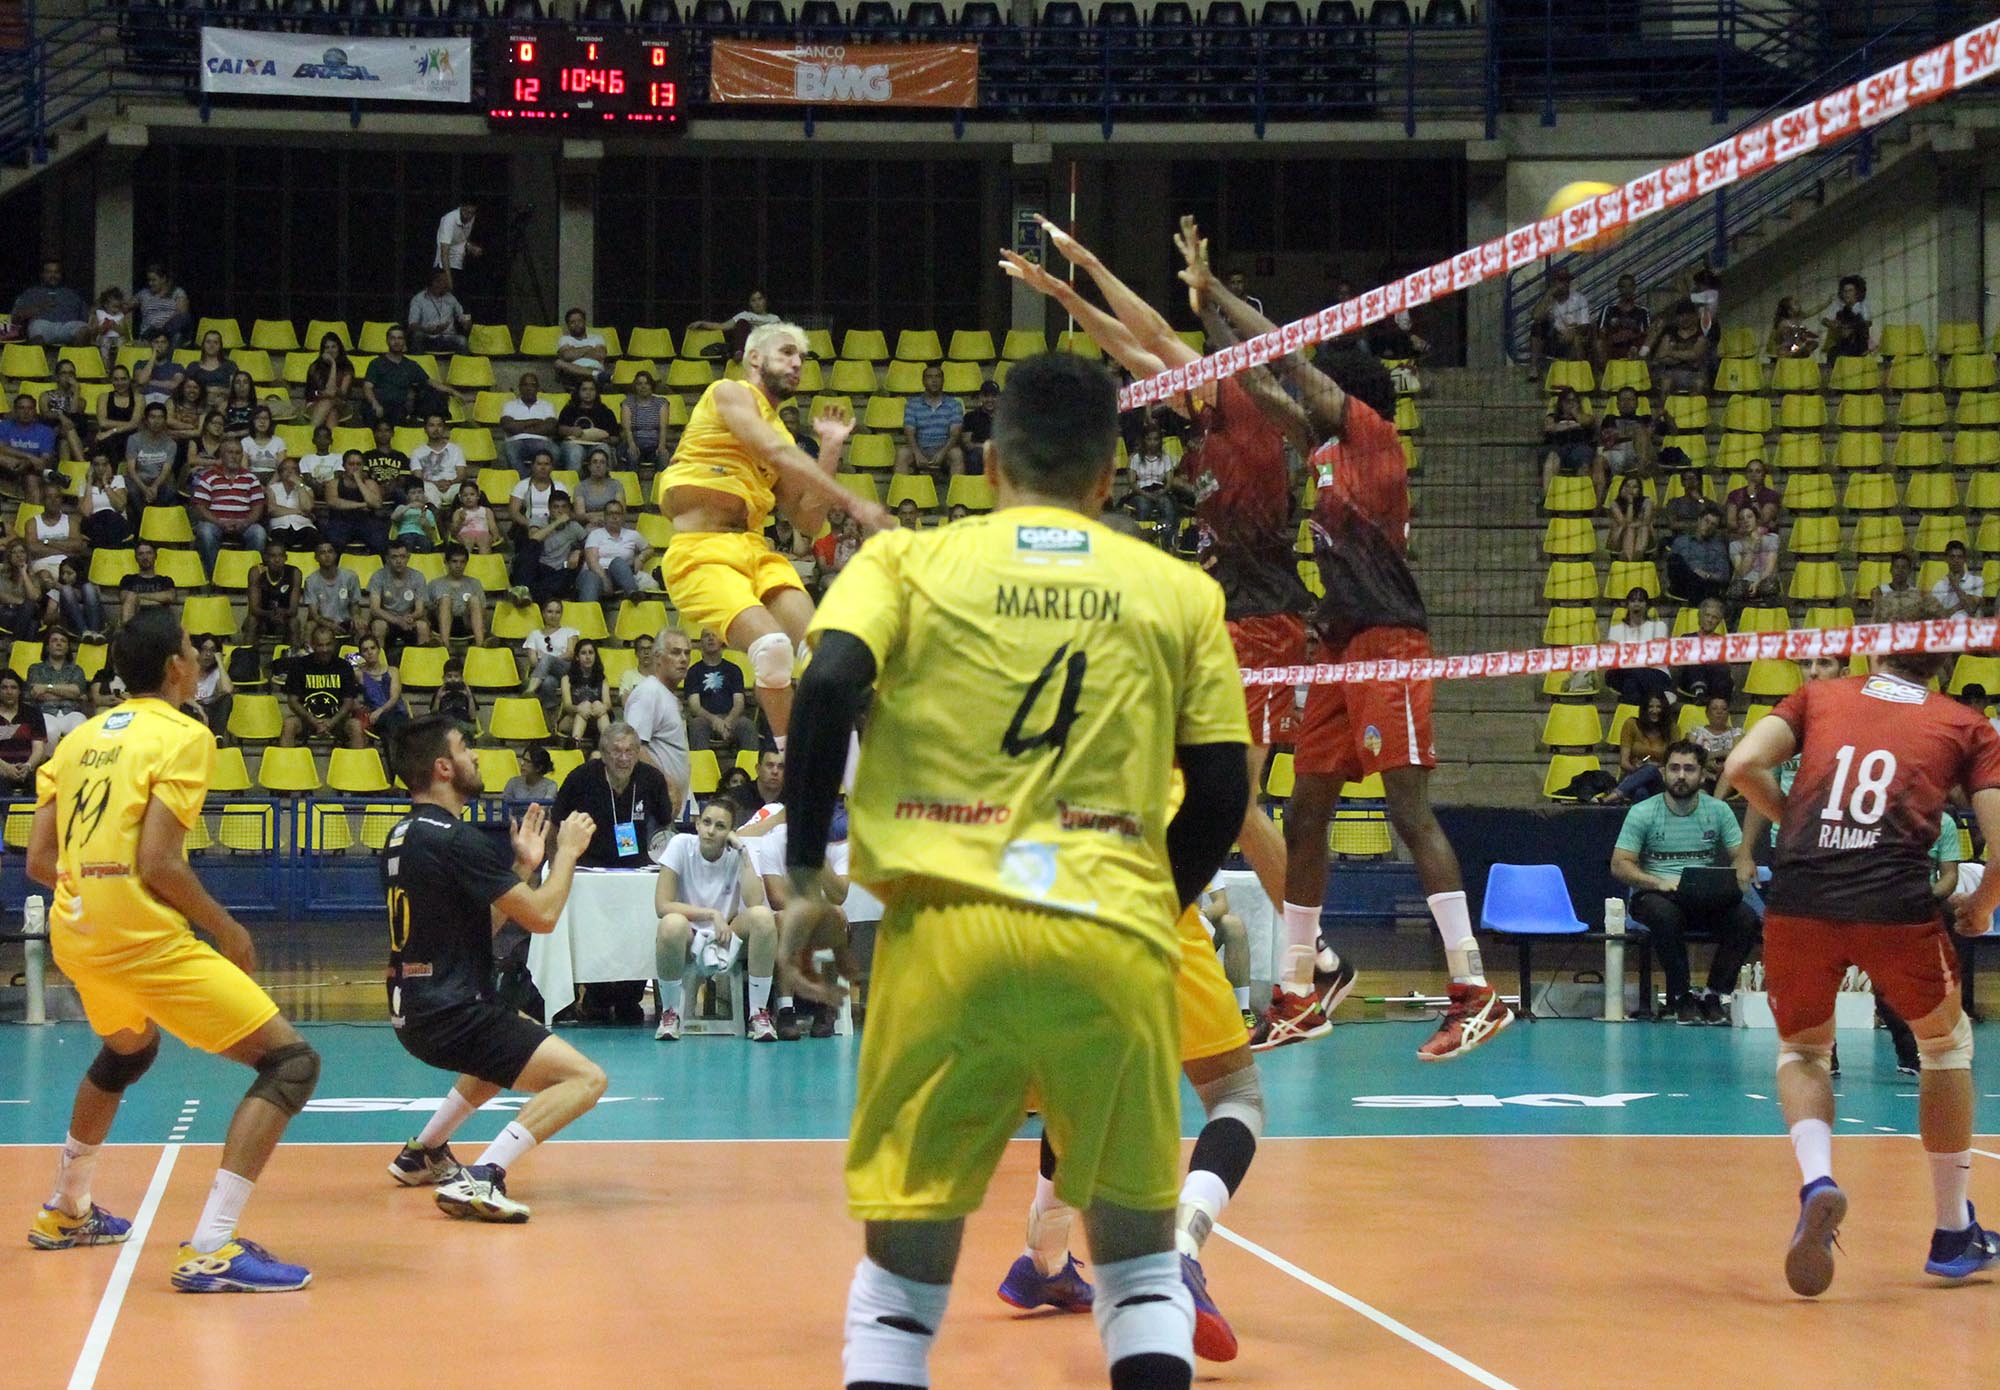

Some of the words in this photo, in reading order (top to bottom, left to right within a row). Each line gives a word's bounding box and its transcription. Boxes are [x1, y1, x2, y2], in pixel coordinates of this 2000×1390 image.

[520, 43, 532, 61] 0
[652, 48, 665, 66] 0
[794, 45, 846, 59] BANCO
[206, 57, 277, 77] CAIXA
[292, 62, 380, 81] BRASIL
[515, 78, 540, 102] 12
[561, 68, 625, 94] 10:46
[794, 64, 892, 102] BMG
[650, 82, 676, 107] 13
[1570, 206, 1591, 238] SKY
[1633, 176, 1655, 213] SKY
[1665, 160, 1692, 200] SKY
[1704, 144, 1728, 185] SKY
[1740, 125, 1769, 169] SKY
[1781, 110, 1808, 151] SKY
[1819, 84, 1854, 135] SKY
[1866, 67, 1898, 115] SKY
[1911, 45, 1951, 95] SKY
[996, 584, 1121, 623] MARLON
[305, 674, 342, 689] NIRVANA
[1002, 640, 1086, 778] 4
[1820, 745, 1897, 825] 18
[64, 777, 112, 851] 19
[895, 799, 1012, 825] mambo
[1818, 825, 1882, 850] RAMMÉ
[1351, 1092, 1659, 1107] SKY
